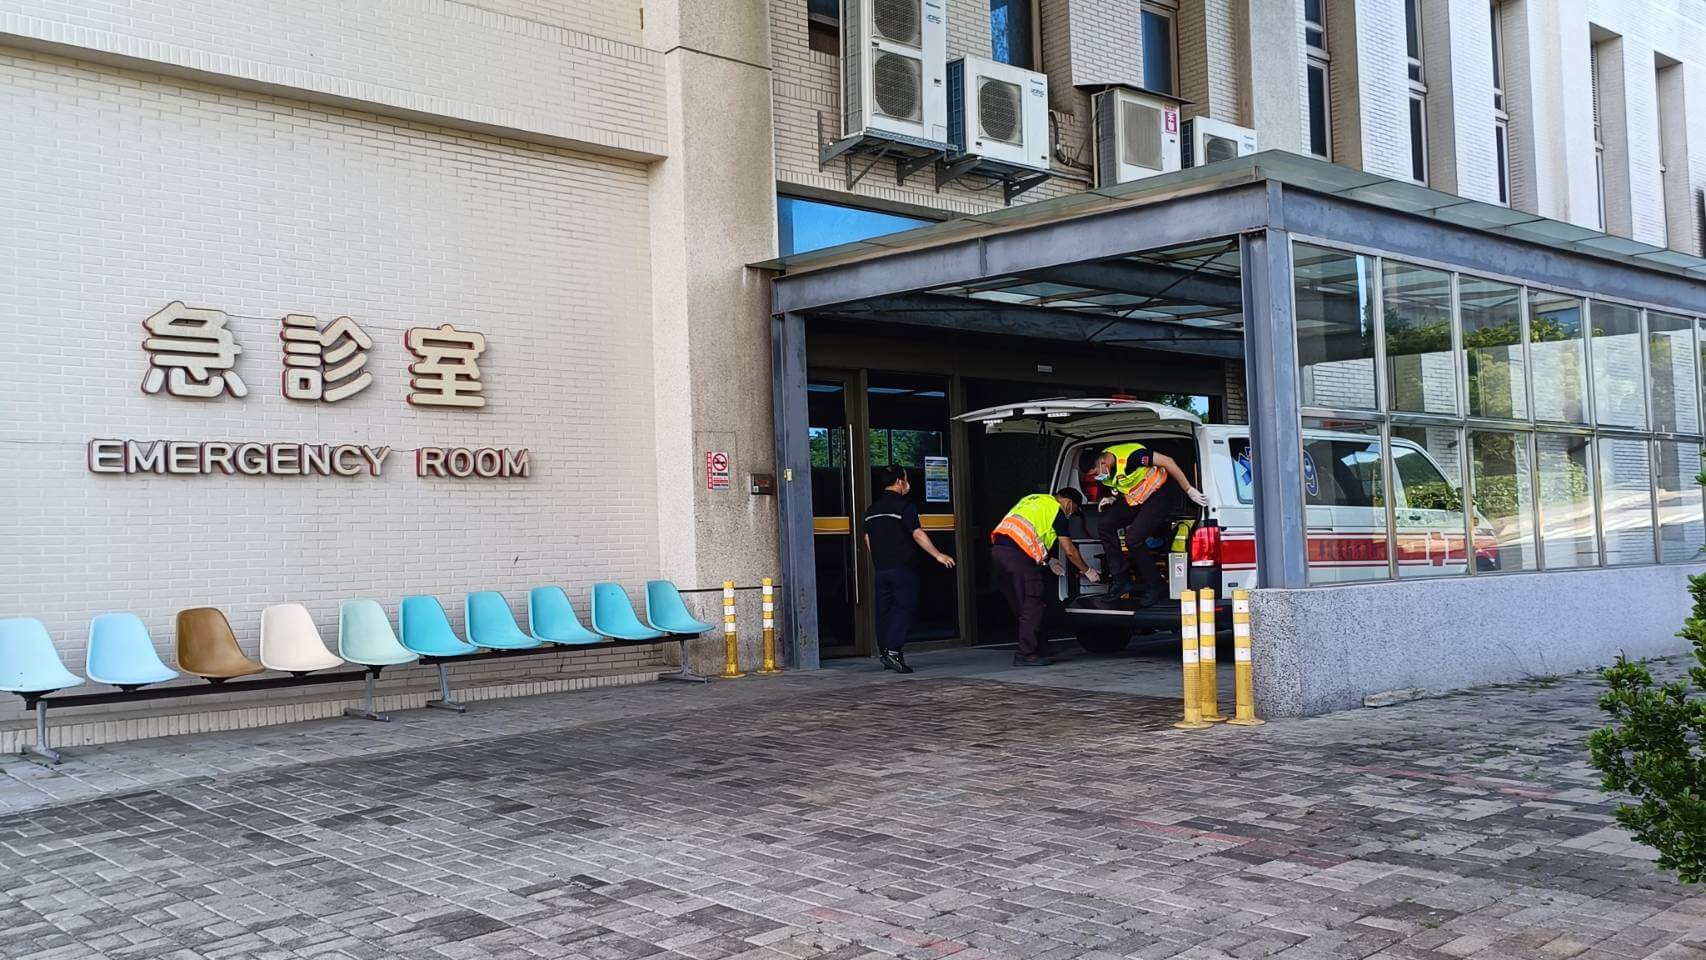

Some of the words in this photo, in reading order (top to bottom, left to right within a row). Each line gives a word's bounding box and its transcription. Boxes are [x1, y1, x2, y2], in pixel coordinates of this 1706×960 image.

[142, 300, 487, 408] 急診室
[88, 438, 391, 476] EMERGENCY
[416, 446, 529, 479] ROOM
